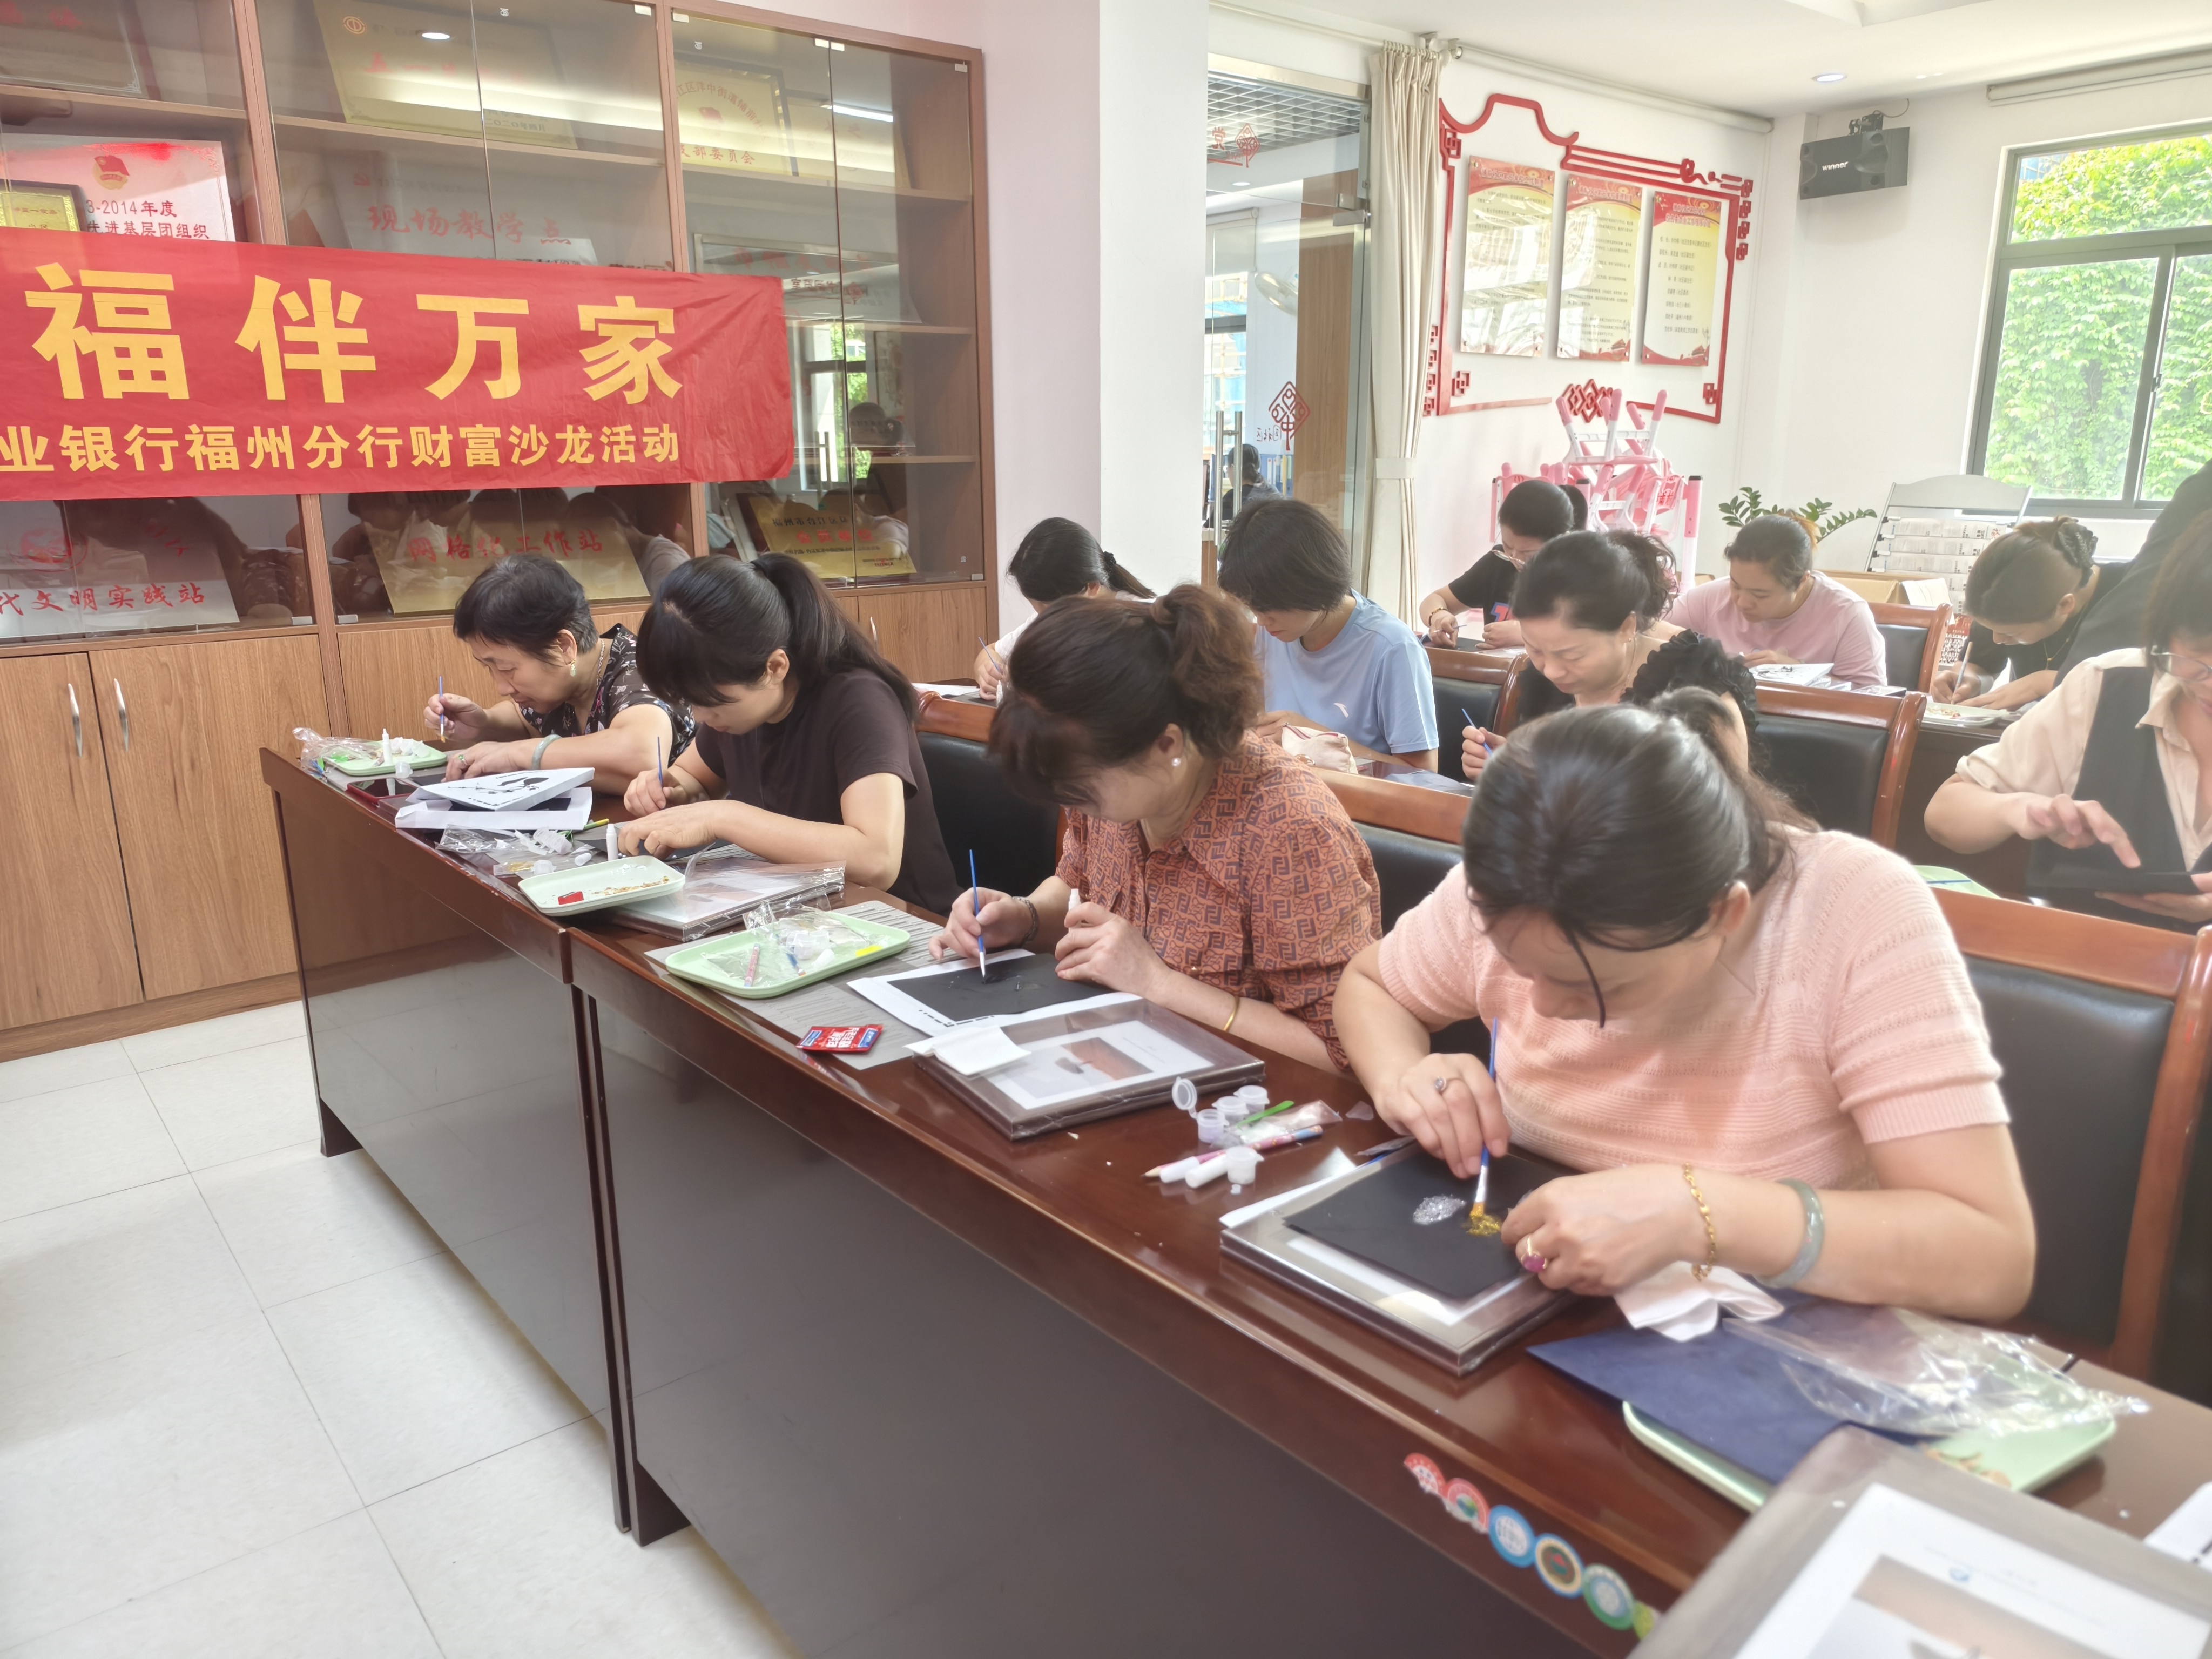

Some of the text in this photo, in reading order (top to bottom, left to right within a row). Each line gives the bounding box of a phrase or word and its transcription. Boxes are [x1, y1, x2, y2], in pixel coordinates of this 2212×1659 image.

[1822, 161, 1849, 171] winner
[368, 204, 572, 245] 现场教学点
[25, 262, 683, 404] 福伴万家
[0, 423, 679, 472] 业银行福州分行财富沙龙活动
[407, 530, 603, 562] 网格化工作站
[0, 582, 205, 616] 代文明实践站
